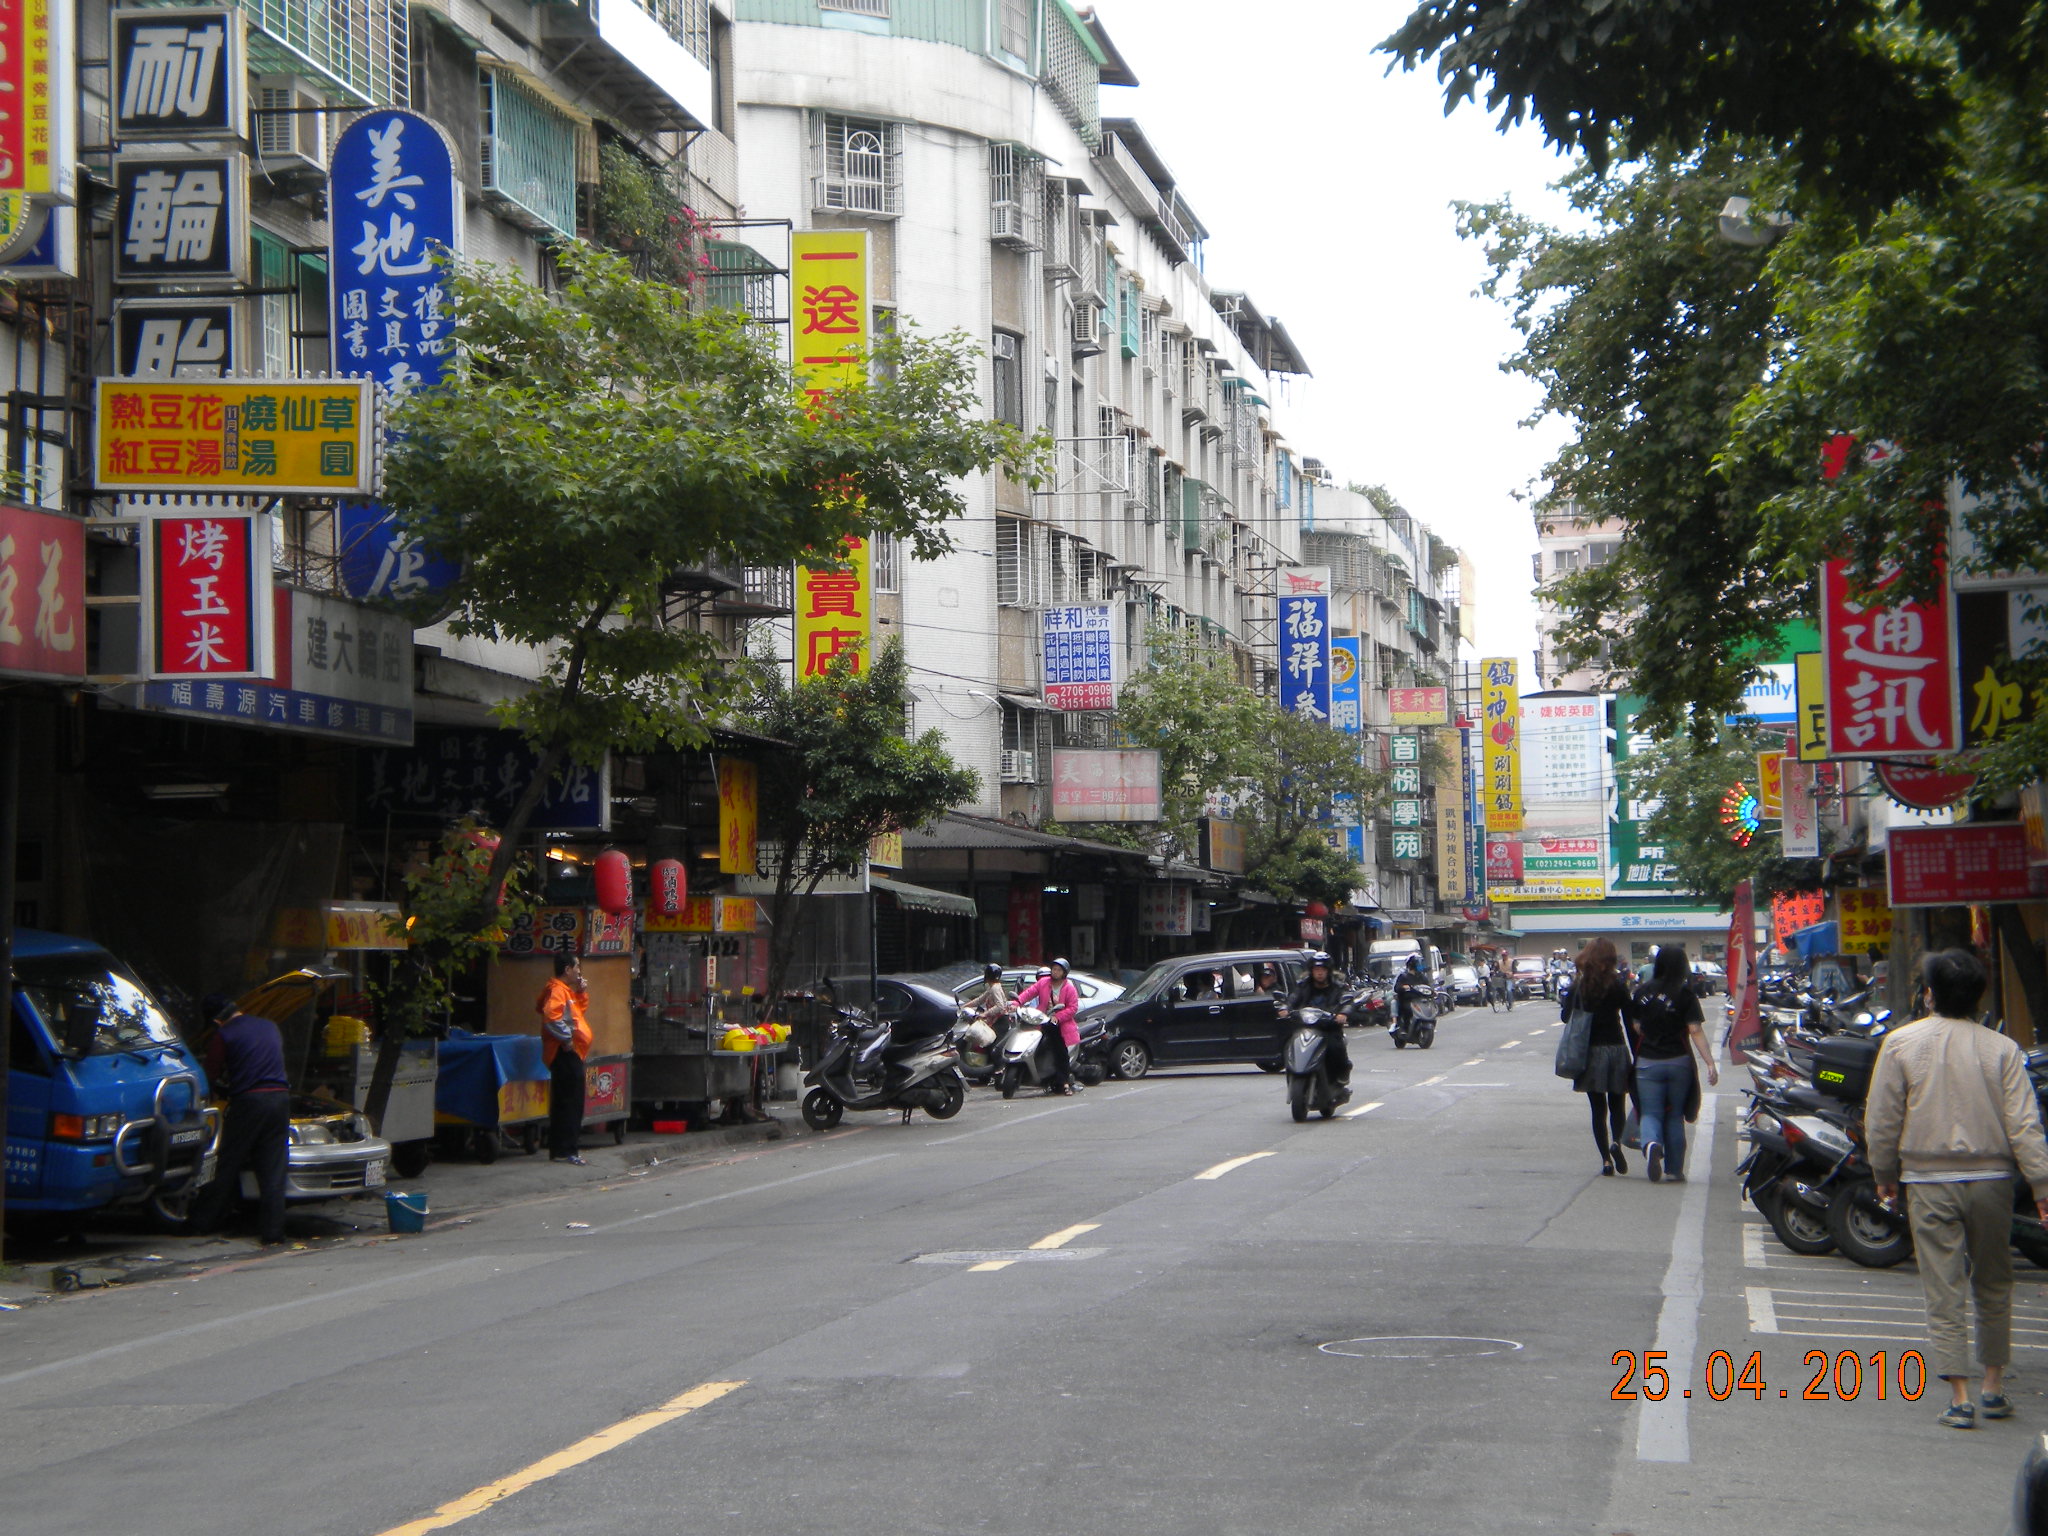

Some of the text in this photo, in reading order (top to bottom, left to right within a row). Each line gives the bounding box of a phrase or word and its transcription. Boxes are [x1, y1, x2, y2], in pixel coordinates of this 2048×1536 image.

[351, 118, 434, 277] 美地
[342, 288, 369, 358] 圖書
[377, 286, 410, 357] 文具
[110, 393, 223, 431] 熱豆花
[241, 394, 355, 432] 燒仙草
[109, 438, 221, 476] 紅豆湯
[242, 440, 354, 476] 湯圓
[178, 518, 232, 672] 烤玉米
[1085, 606, 1108, 615] 代書
[1045, 607, 1082, 630] 祥和
[1086, 618, 1109, 628] 仲介
[1073, 632, 1083, 680] 抵押貸款
[1099, 631, 1110, 679] 祭祀公業
[1060, 686, 1111, 697] 2706-0909
[1061, 697, 1112, 709] 3151-1618
[1741, 680, 1792, 700] amily
[1621, 916, 1686, 929] 全家 FamilyMart
[171, 1129, 201, 1144] MITSUBISH
